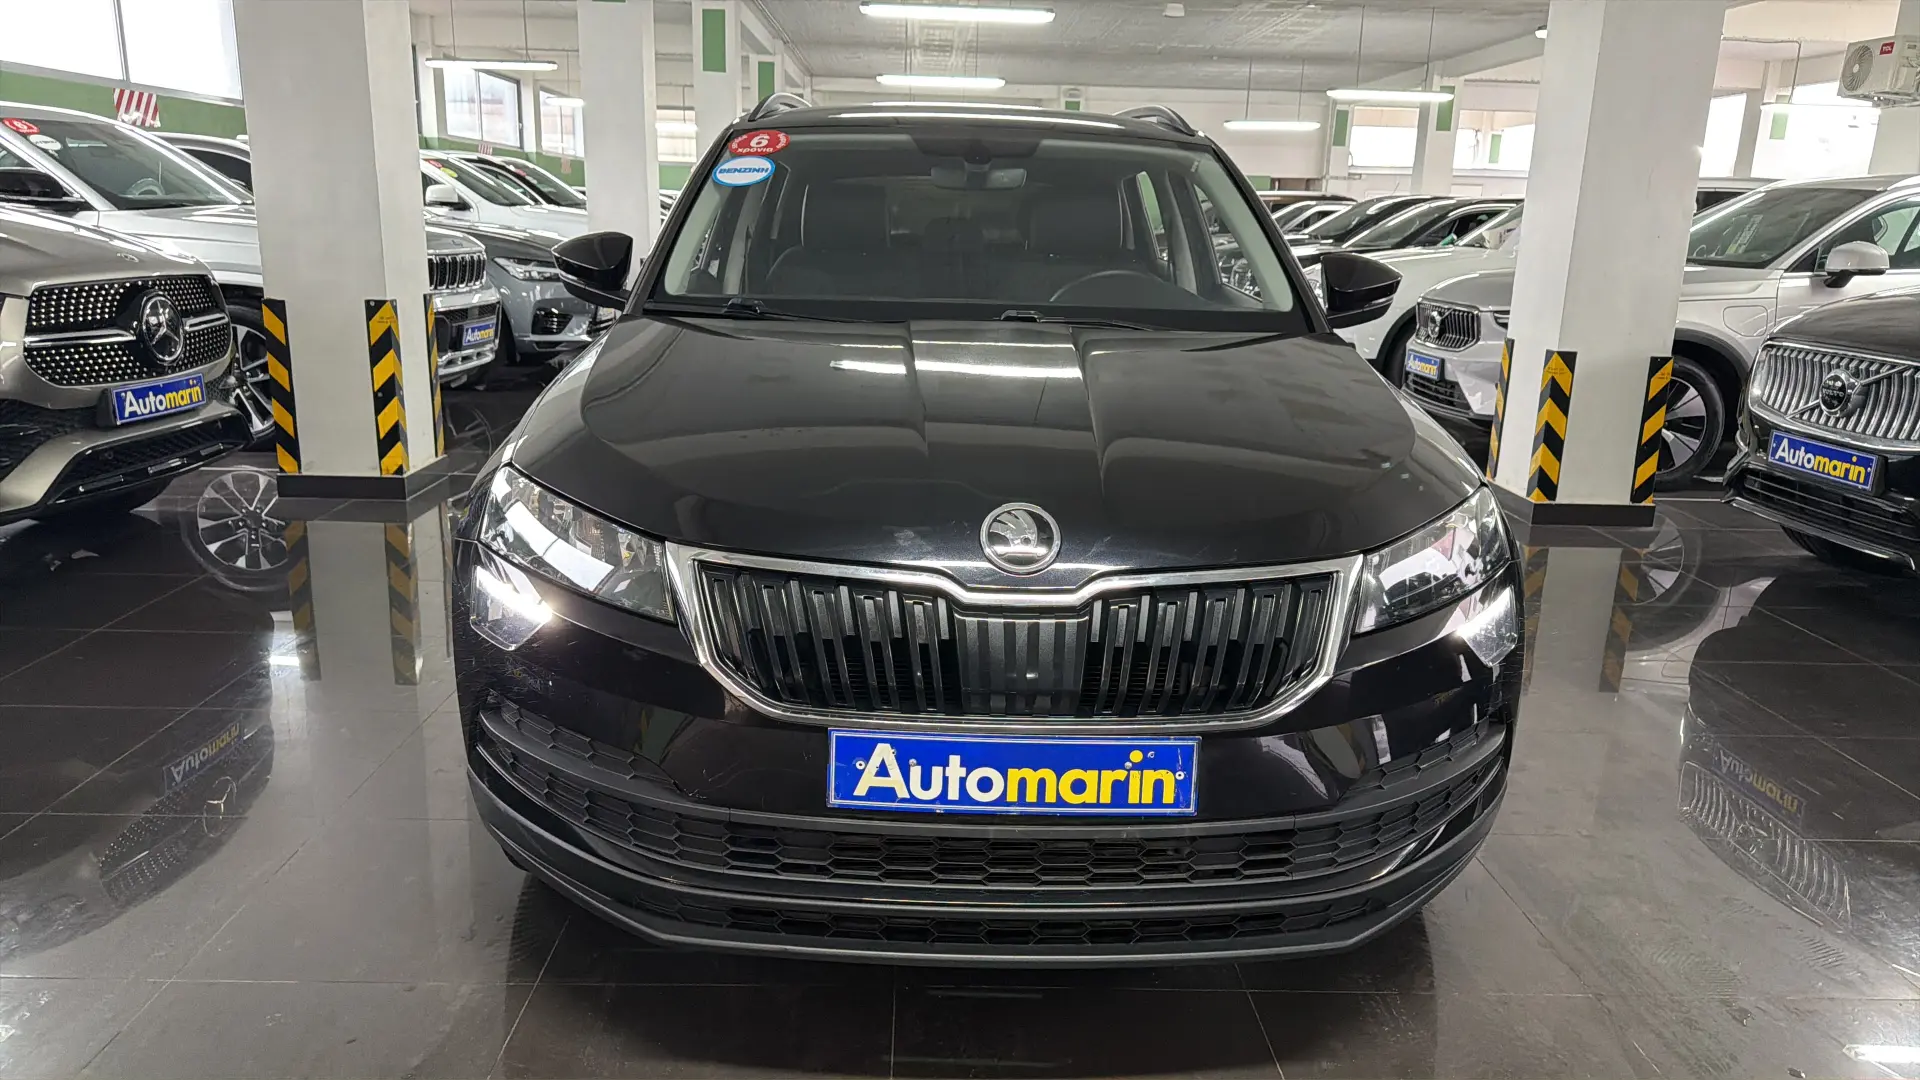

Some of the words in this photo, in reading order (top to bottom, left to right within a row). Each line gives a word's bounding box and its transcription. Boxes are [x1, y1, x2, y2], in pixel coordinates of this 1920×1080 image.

[749, 134, 771, 148] 6
[124, 379, 202, 418] Automarin
[1774, 438, 1866, 484] Automarin
[853, 742, 1176, 804] Automarin
